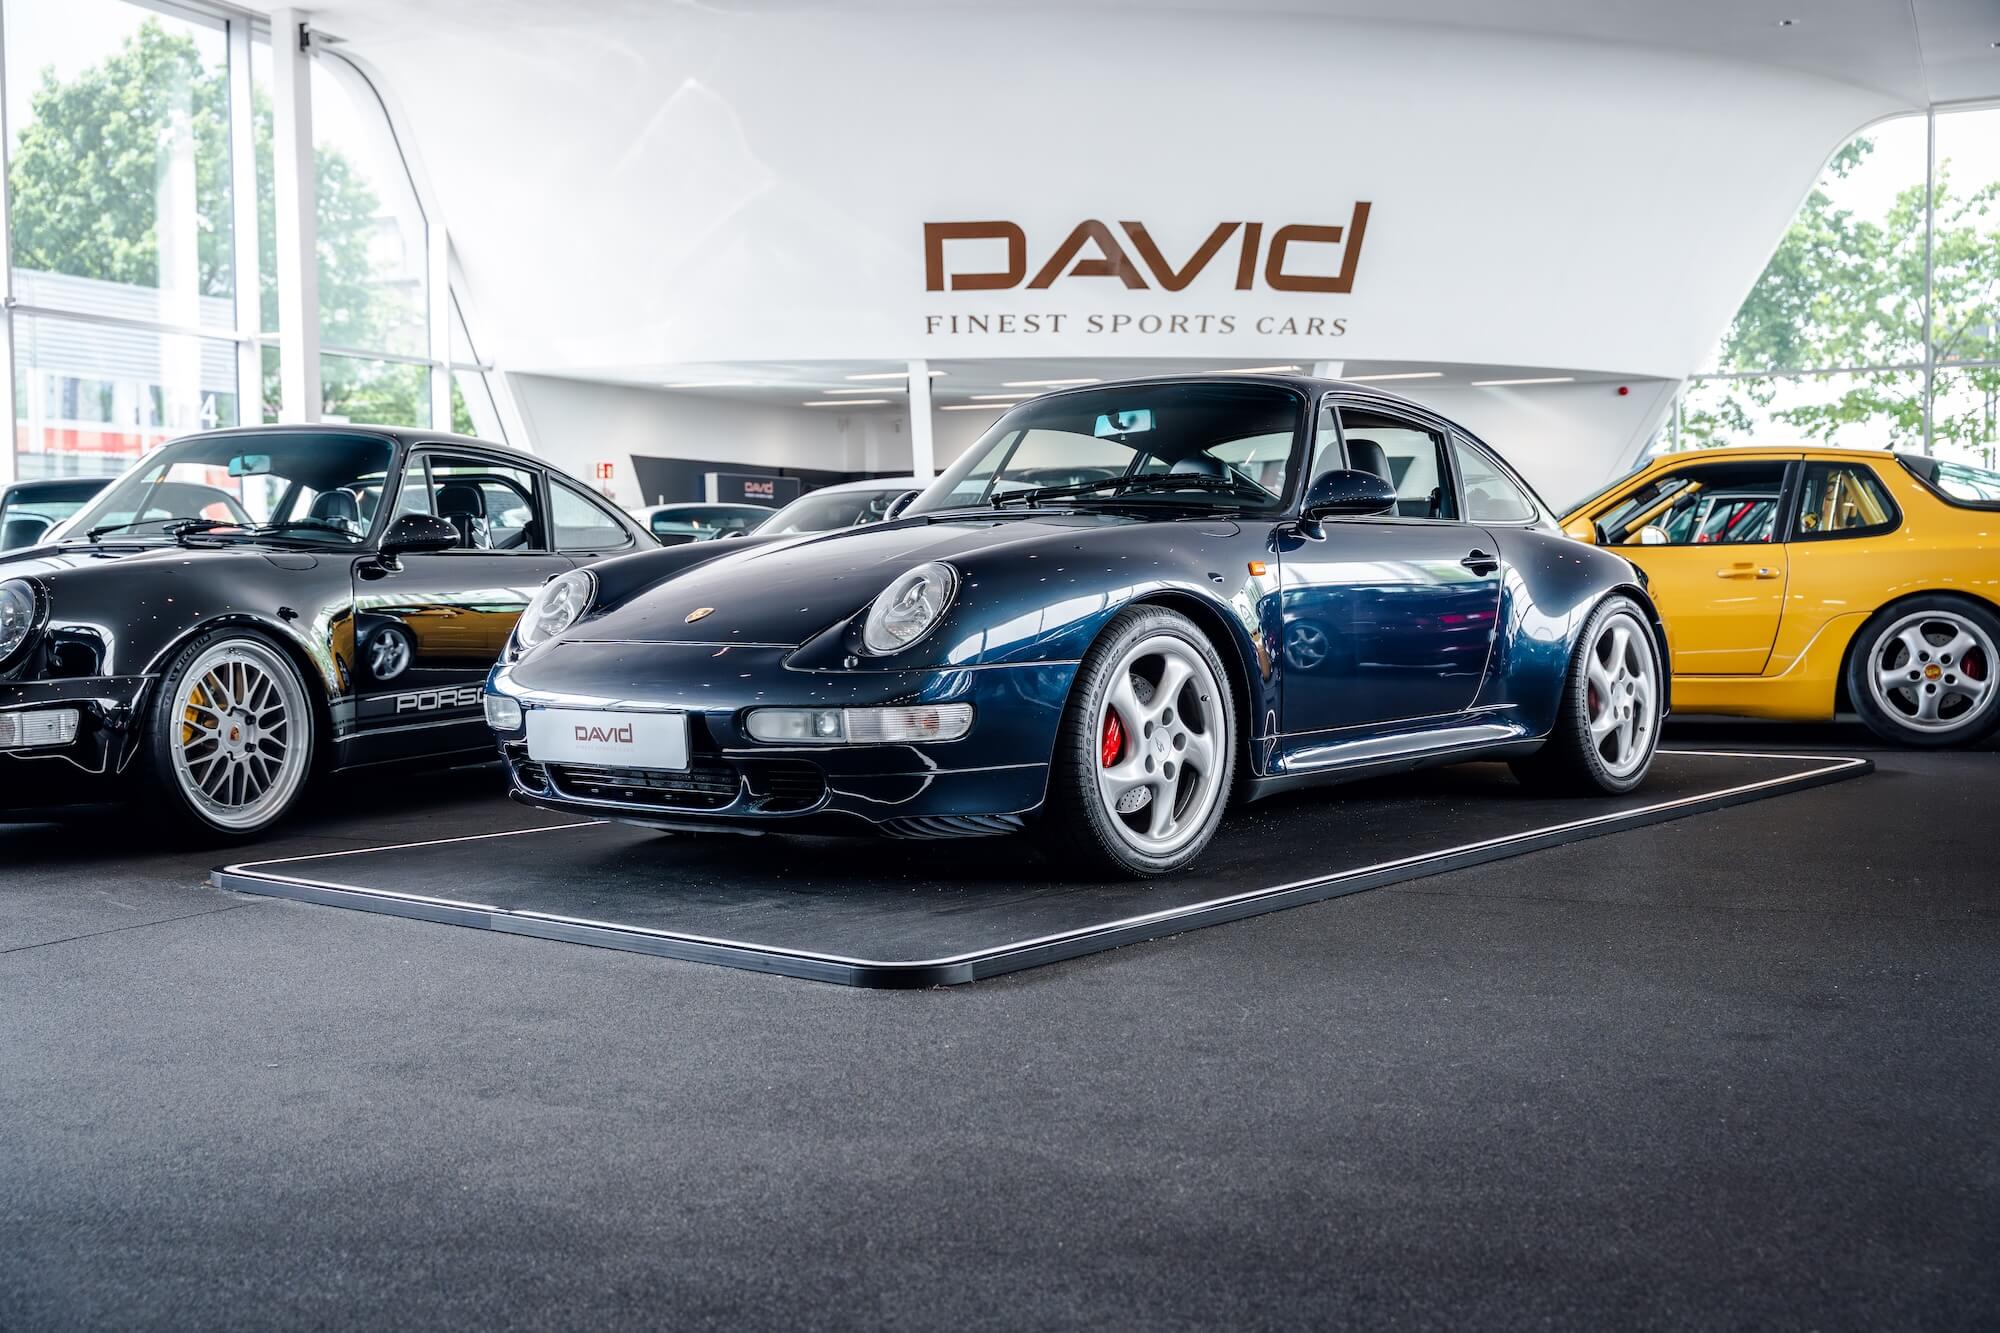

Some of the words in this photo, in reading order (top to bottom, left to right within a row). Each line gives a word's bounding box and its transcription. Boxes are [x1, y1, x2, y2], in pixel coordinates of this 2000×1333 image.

[925, 314, 1067, 334] FINEST
[1087, 314, 1236, 334] SPORTS
[1256, 316, 1348, 337] CARS
